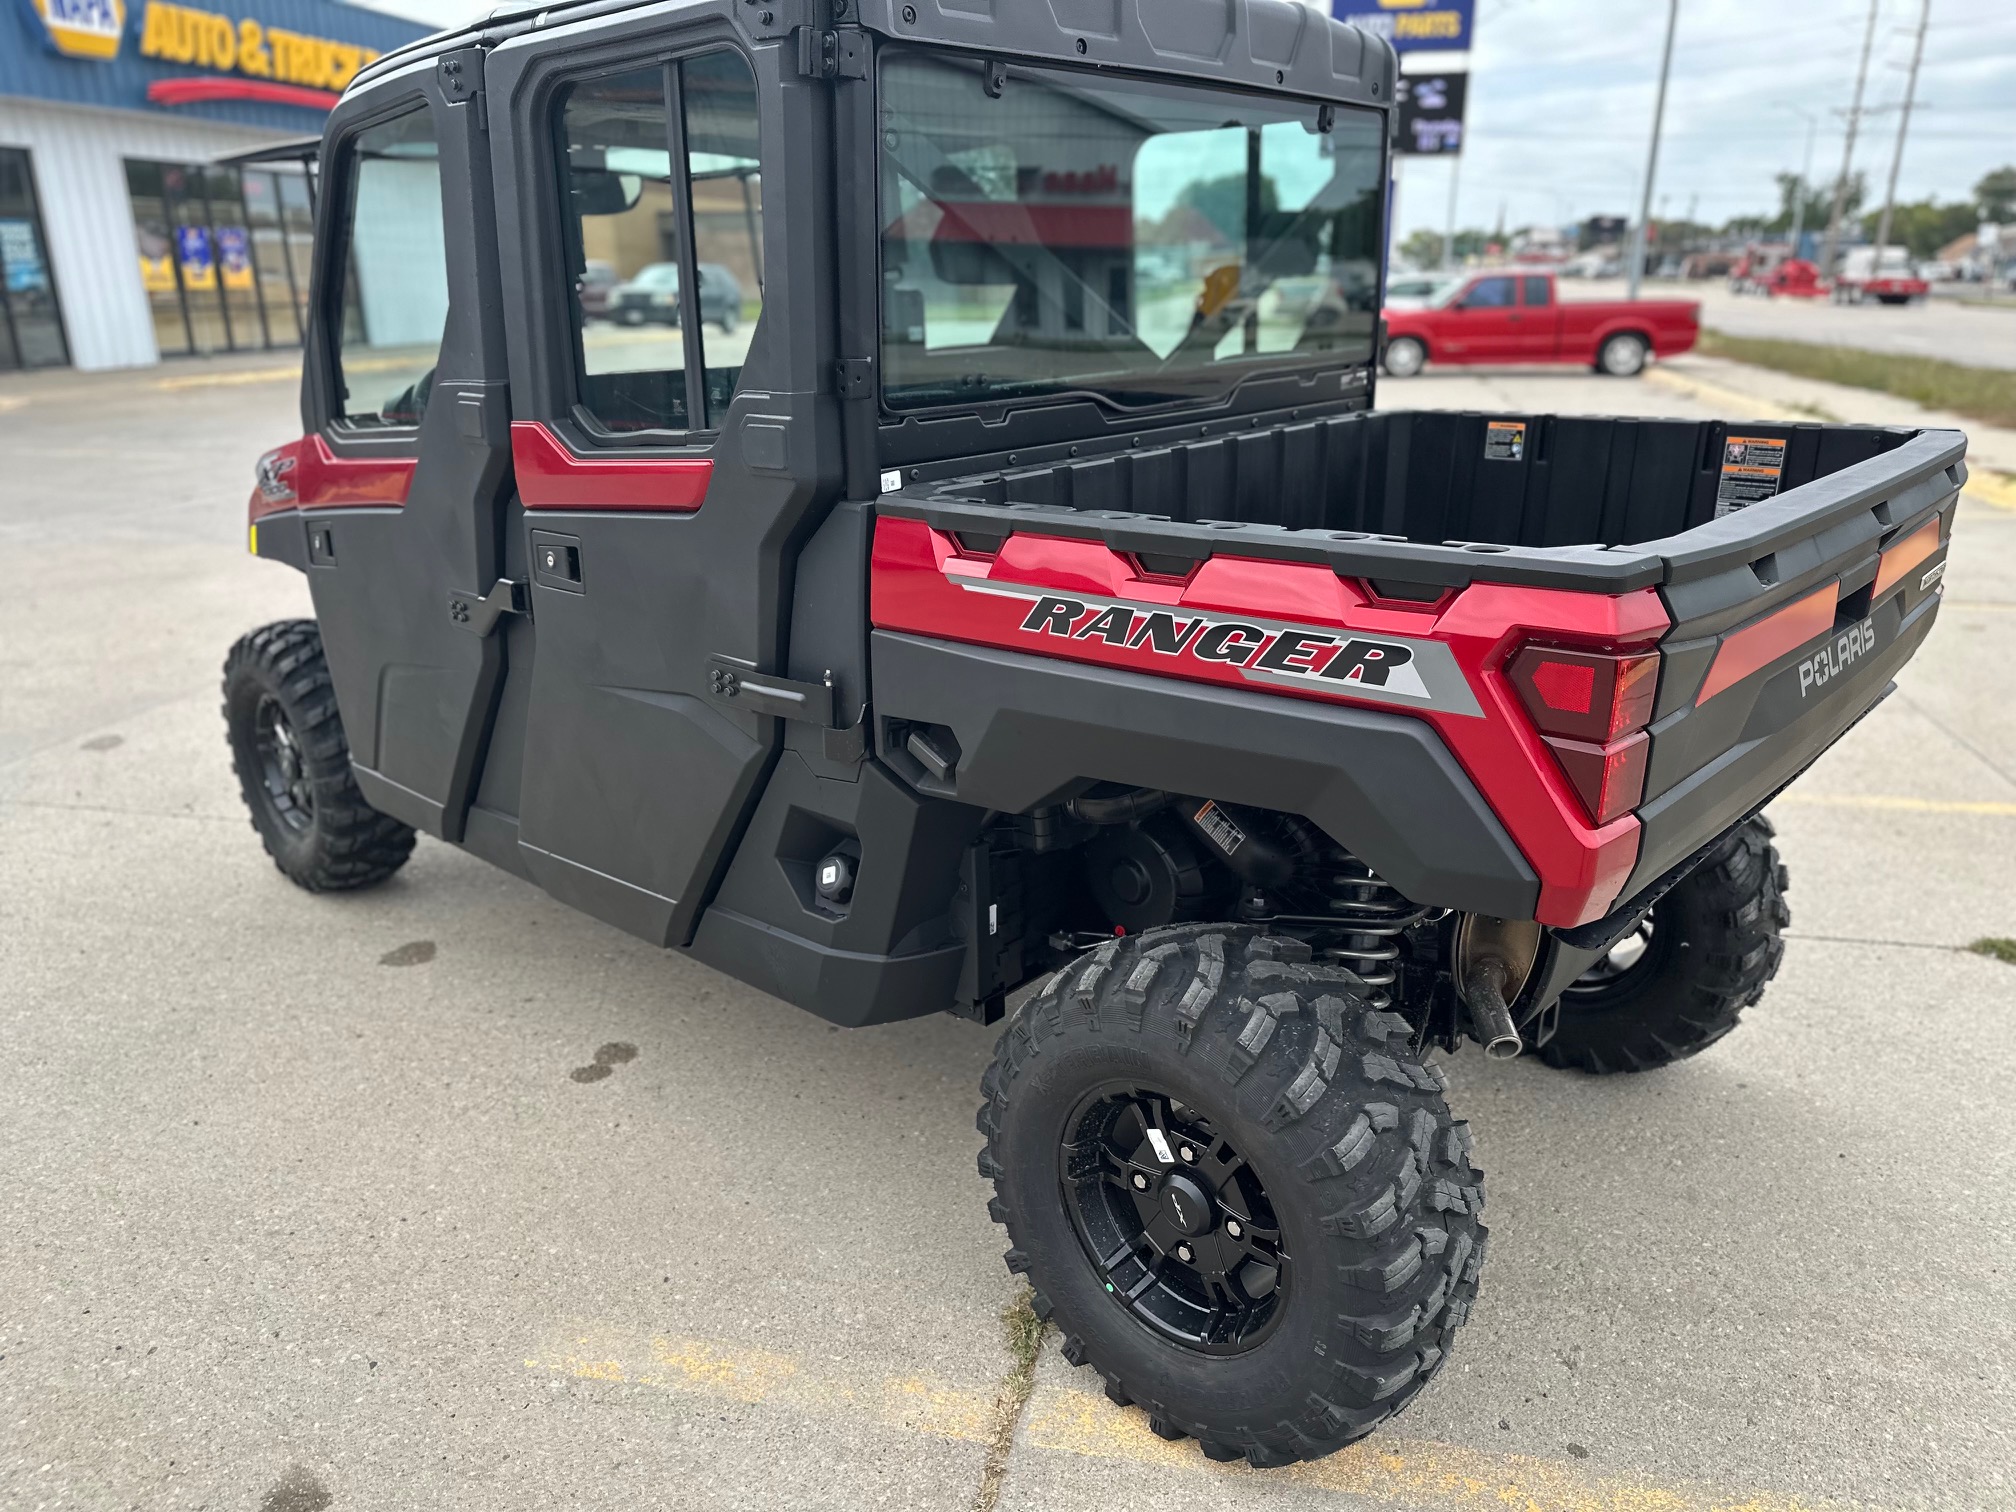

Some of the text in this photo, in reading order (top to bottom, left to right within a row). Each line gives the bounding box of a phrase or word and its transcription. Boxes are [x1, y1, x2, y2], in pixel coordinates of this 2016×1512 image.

[142, 2, 236, 71] AUTO
[239, 19, 270, 76] &
[1395, 10, 1461, 38] PARTS
[1020, 595, 1414, 687] RANGER
[1799, 617, 1875, 697] POLARIS
